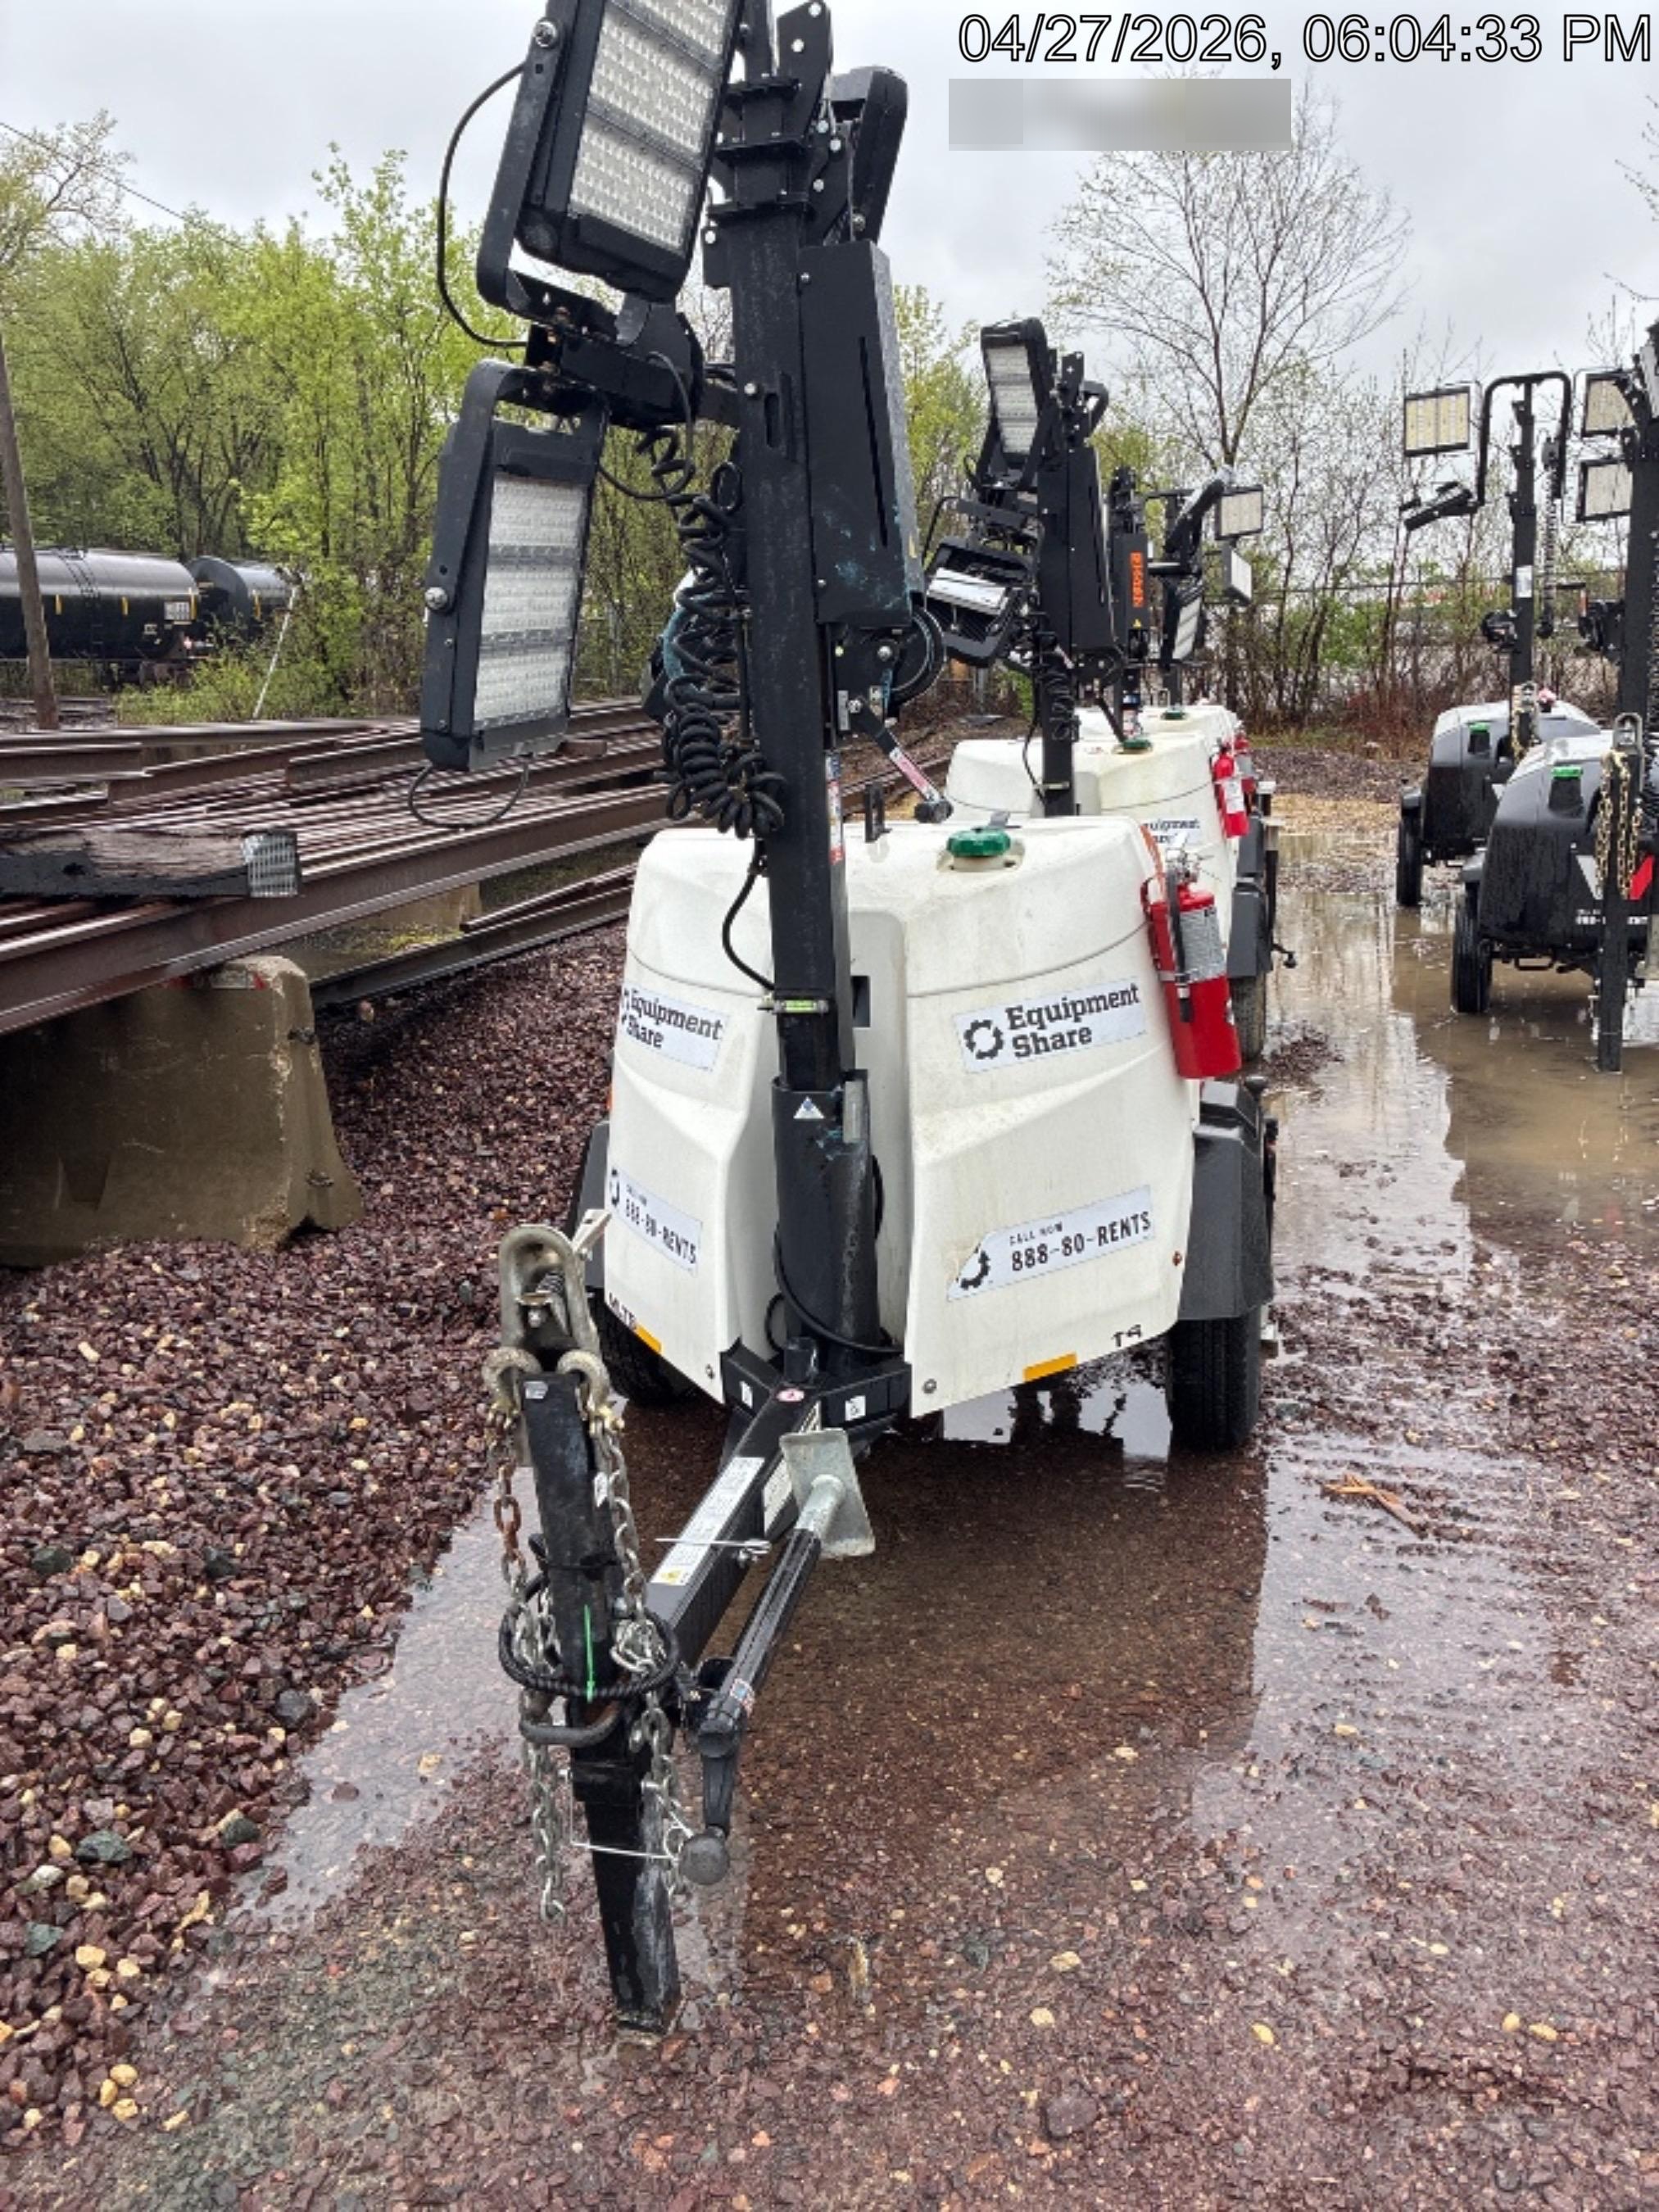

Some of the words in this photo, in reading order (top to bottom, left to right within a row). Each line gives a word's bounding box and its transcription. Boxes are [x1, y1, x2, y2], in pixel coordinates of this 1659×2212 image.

[630, 987, 723, 1040] Equipment
[1004, 982, 1140, 1031] Equipment
[626, 1014, 664, 1049] Share
[1011, 1026, 1093, 1058] Share
[1009, 1231, 1036, 1246] CALL
[1039, 1221, 1063, 1236] NOW
[1011, 1211, 1152, 1271] 888-80-RENTS
